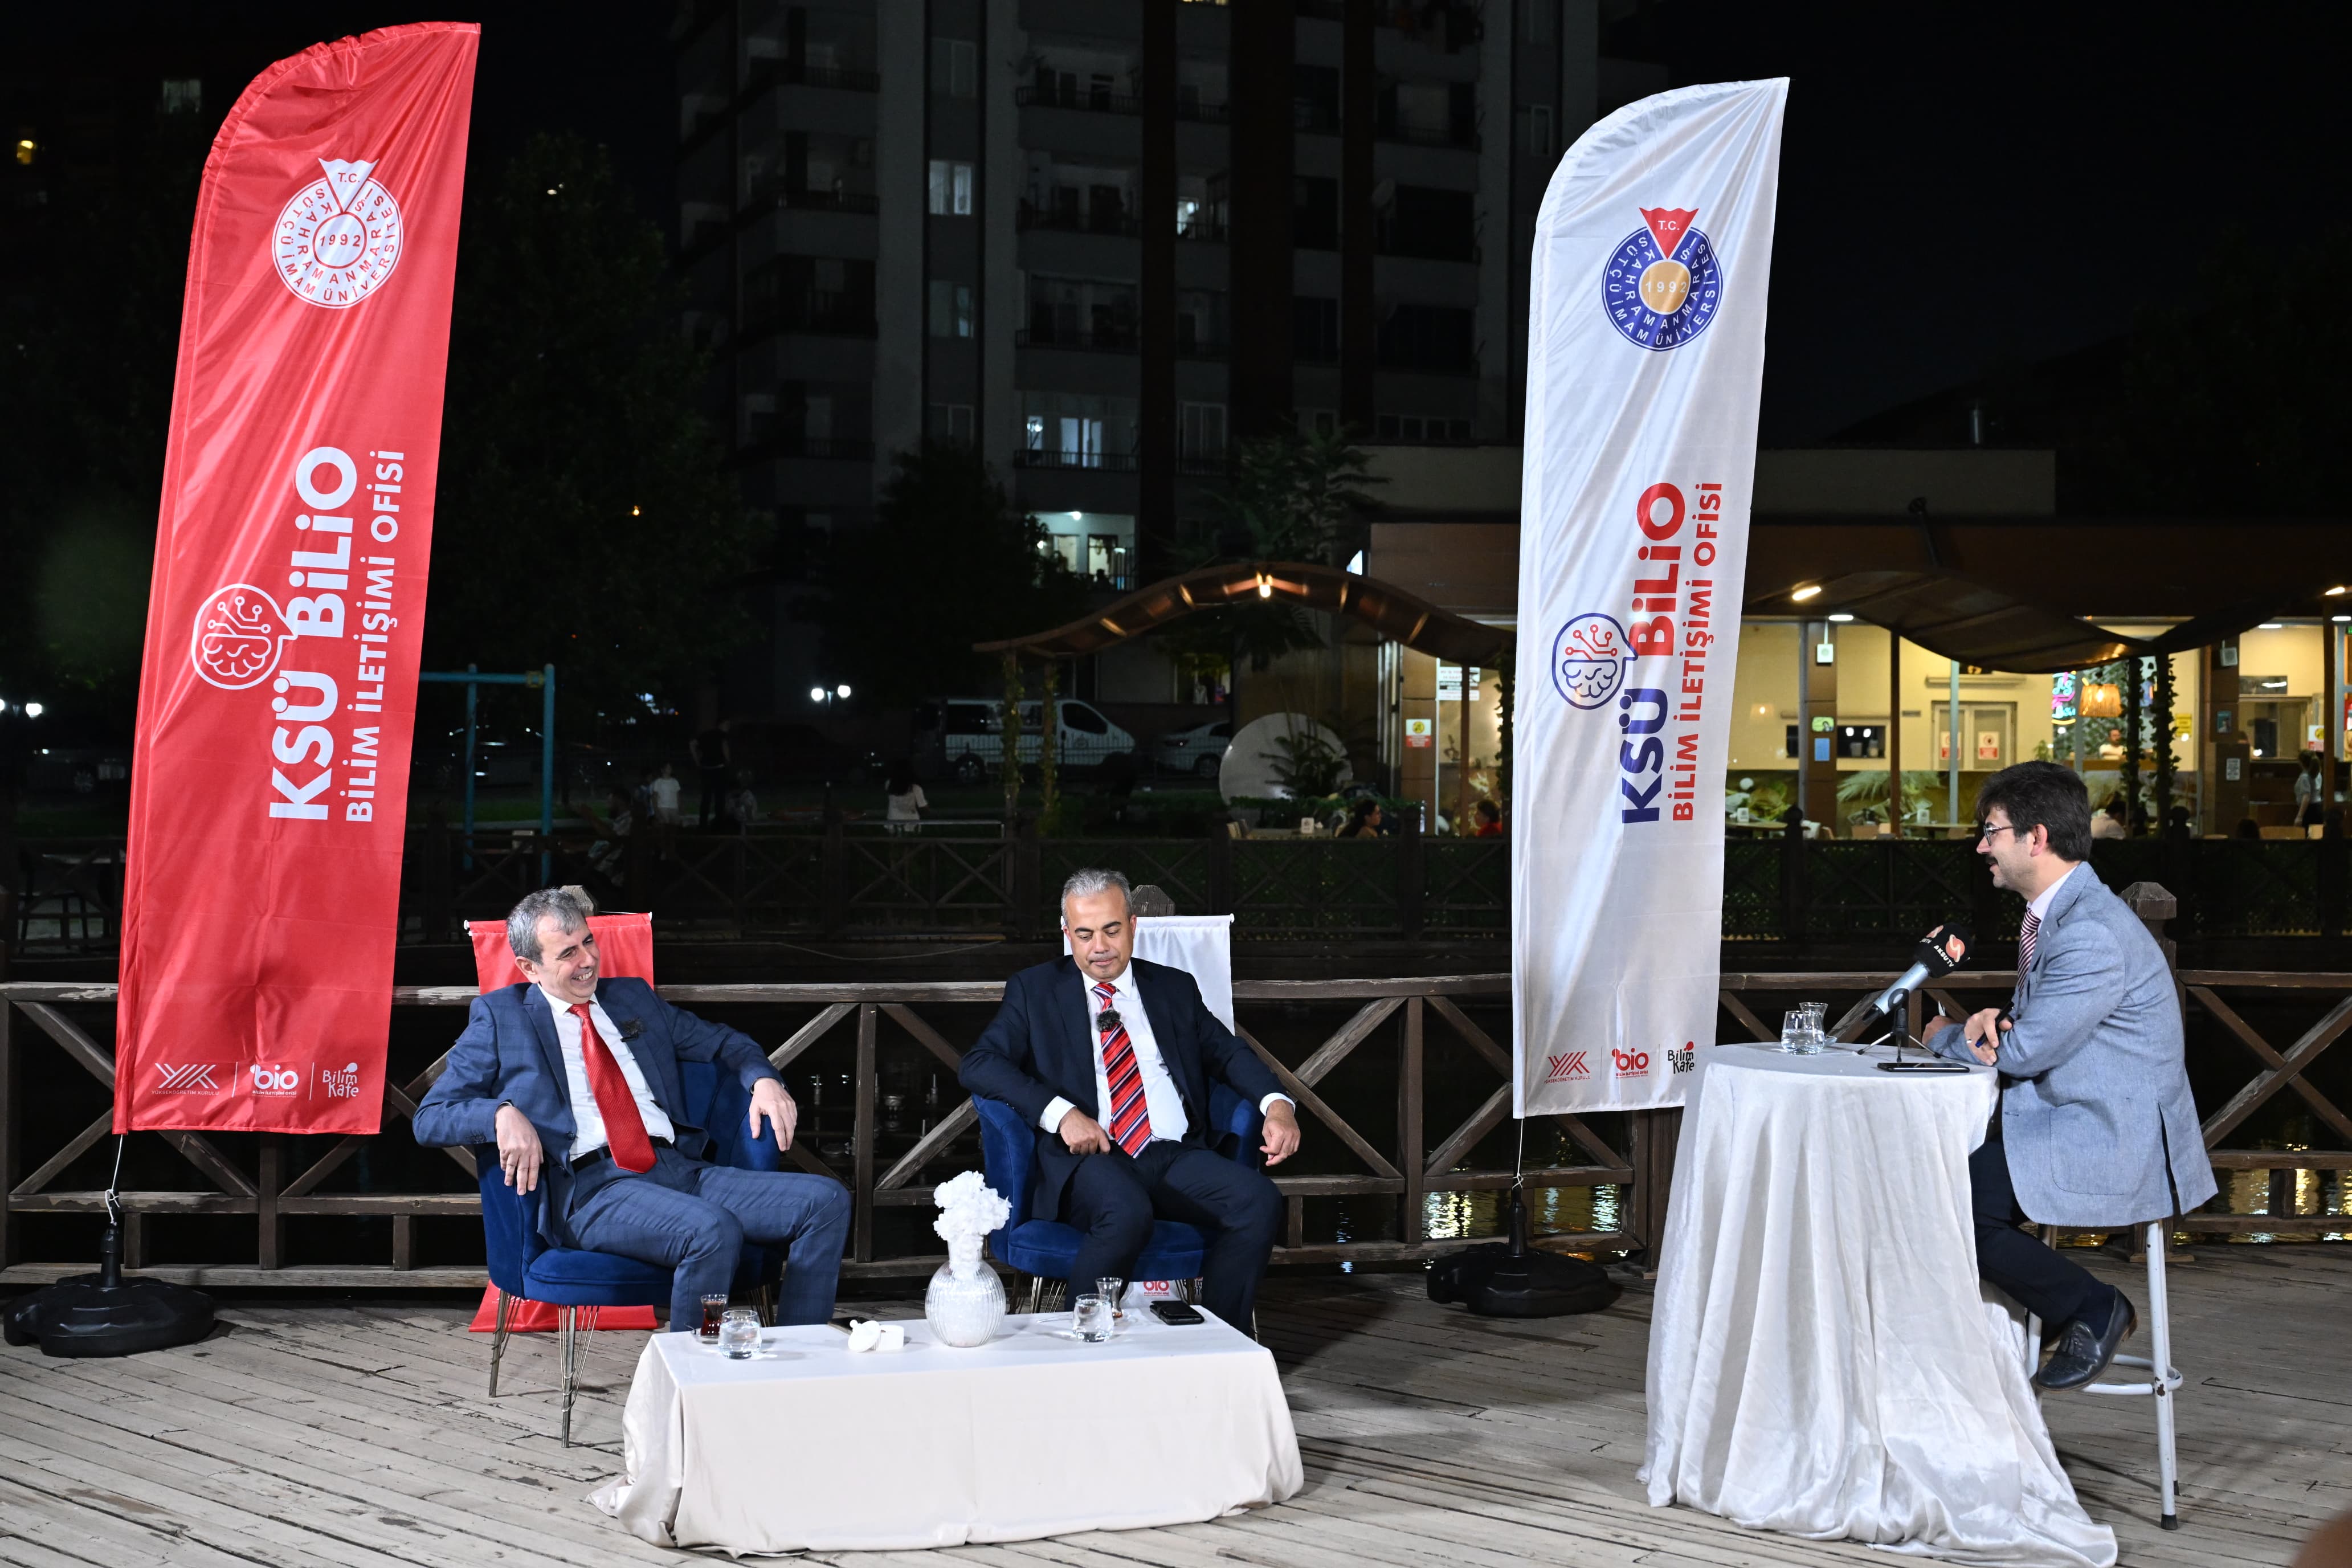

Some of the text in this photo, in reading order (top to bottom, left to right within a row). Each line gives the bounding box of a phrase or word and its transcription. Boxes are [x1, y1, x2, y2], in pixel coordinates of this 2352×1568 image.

[338, 173, 360, 183] T.C.
[1658, 220, 1680, 231] T.C.
[281, 188, 397, 302] SÜTÇÜ İMAM ÜNİVERSİTESİ
[297, 199, 382, 284] KAHRAMANMARAŞ
[319, 234, 361, 247] 1992
[1609, 236, 1648, 292] SÜTÇÜ
[1645, 281, 1688, 293] 1992
[1611, 300, 1648, 341] İMAM
[340, 451, 403, 822] BİLİM İLETİŞİMİ OFİSİ
[1667, 483, 1722, 820] BİLİM İLETİŞİMİ OFİSİ
[270, 670, 338, 820] KSÜ
[1619, 688, 1668, 824] KSÜ
[1612, 1047, 1649, 1071] bio
[1668, 1049, 1694, 1061] Bilim
[1673, 1058, 1694, 1074] Kafe
[250, 1064, 299, 1089] bio
[322, 1070, 357, 1084] Bilim
[328, 1081, 359, 1098] Kafe
